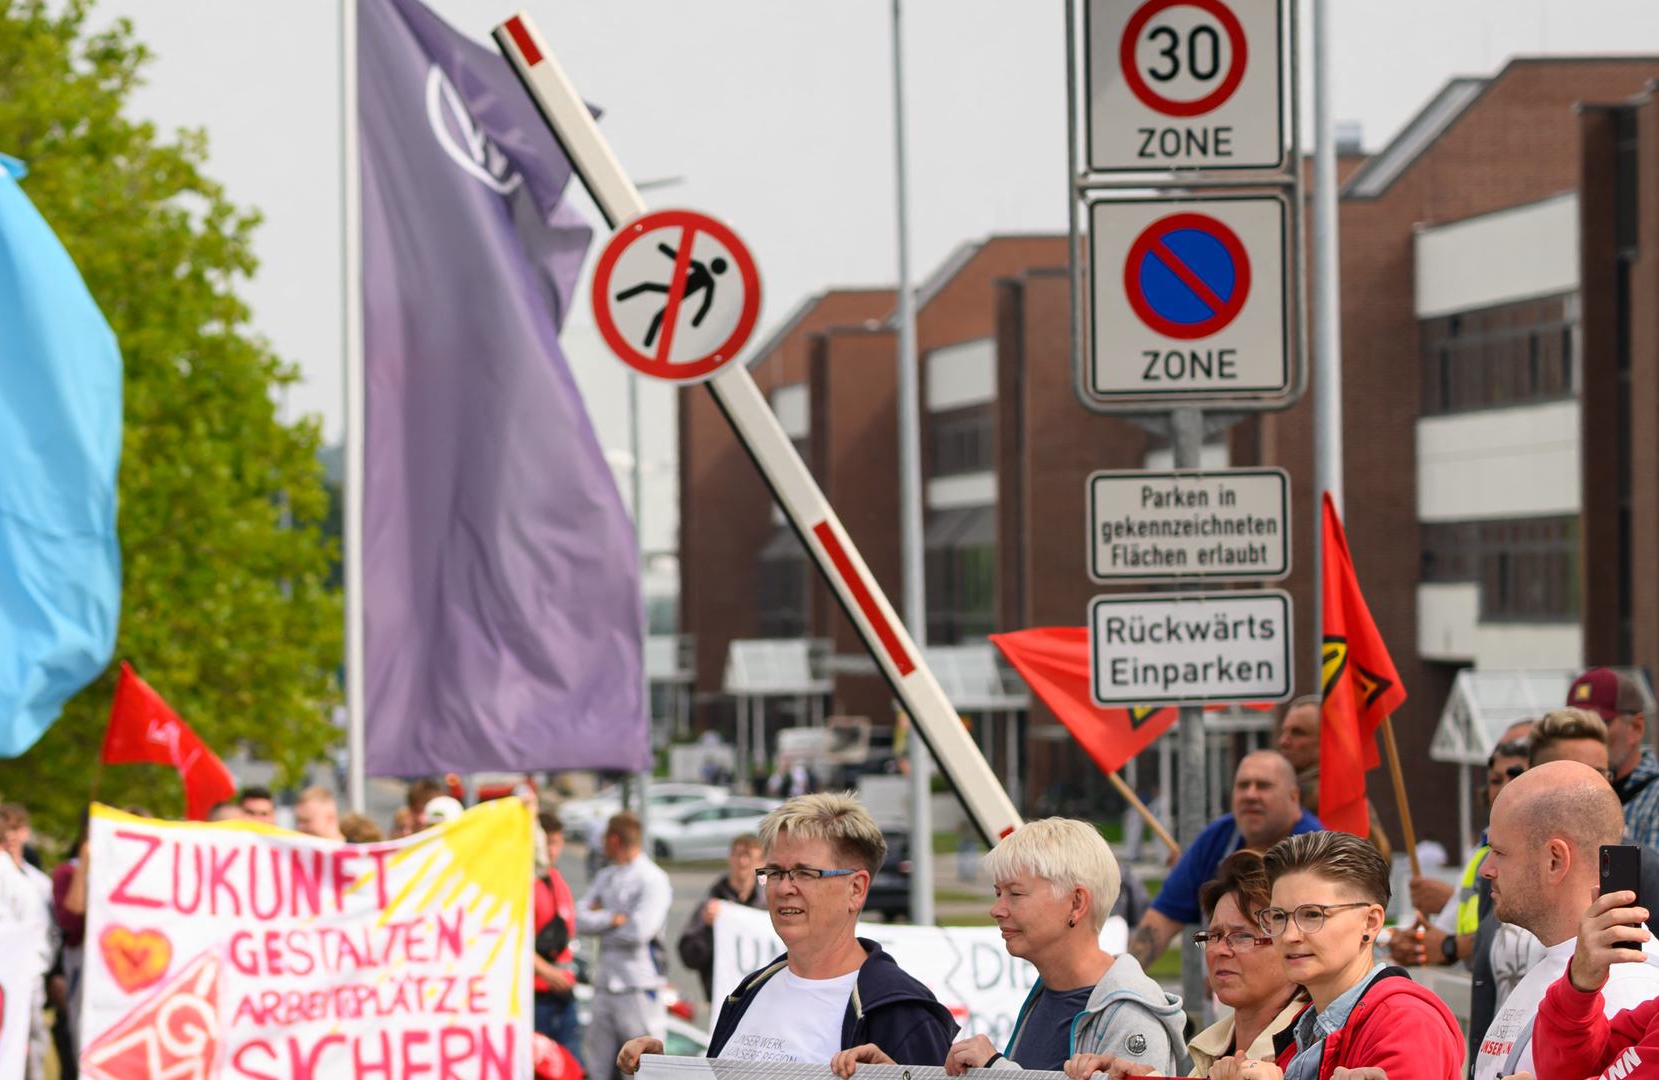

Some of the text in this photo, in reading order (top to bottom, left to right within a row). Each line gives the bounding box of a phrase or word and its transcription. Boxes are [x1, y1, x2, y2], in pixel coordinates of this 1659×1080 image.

[1147, 25, 1220, 82] 30
[1137, 127, 1233, 158] ZONE
[1142, 349, 1237, 381] ZONE
[1141, 484, 1237, 508] Parken in
[1102, 515, 1278, 544] gekennzeichneten
[1111, 543, 1268, 567] Flächen erlaubt
[1106, 613, 1275, 644] Rückwärts
[1111, 655, 1274, 691] Einparken
[107, 829, 399, 921] ZUKUNFT
[230, 907, 464, 977] GESTALTEN
